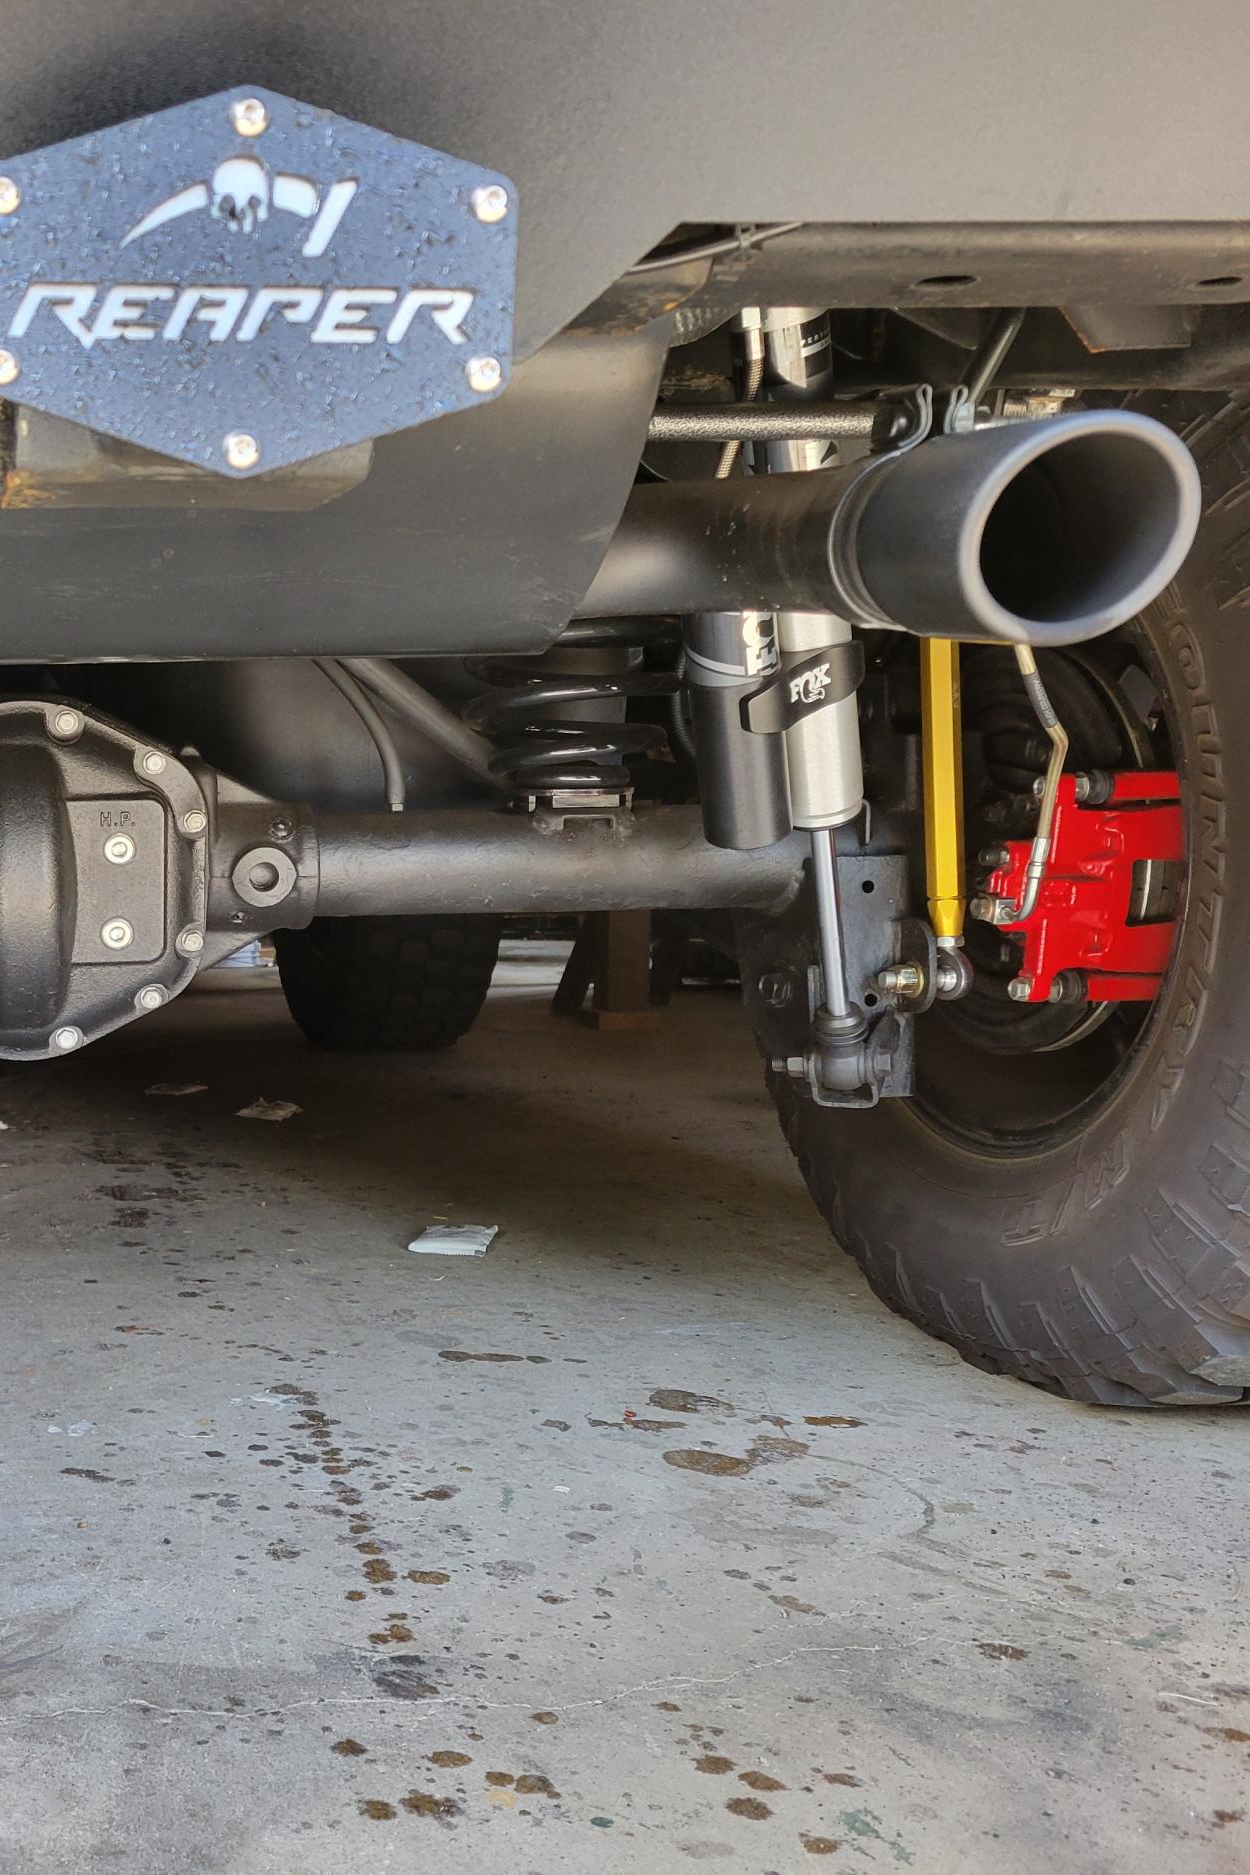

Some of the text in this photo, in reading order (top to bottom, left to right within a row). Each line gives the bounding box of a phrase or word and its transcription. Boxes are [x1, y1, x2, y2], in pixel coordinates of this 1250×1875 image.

[6, 283, 478, 349] REAPER
[789, 663, 832, 703] FOX
[100, 811, 136, 828] H.P.
